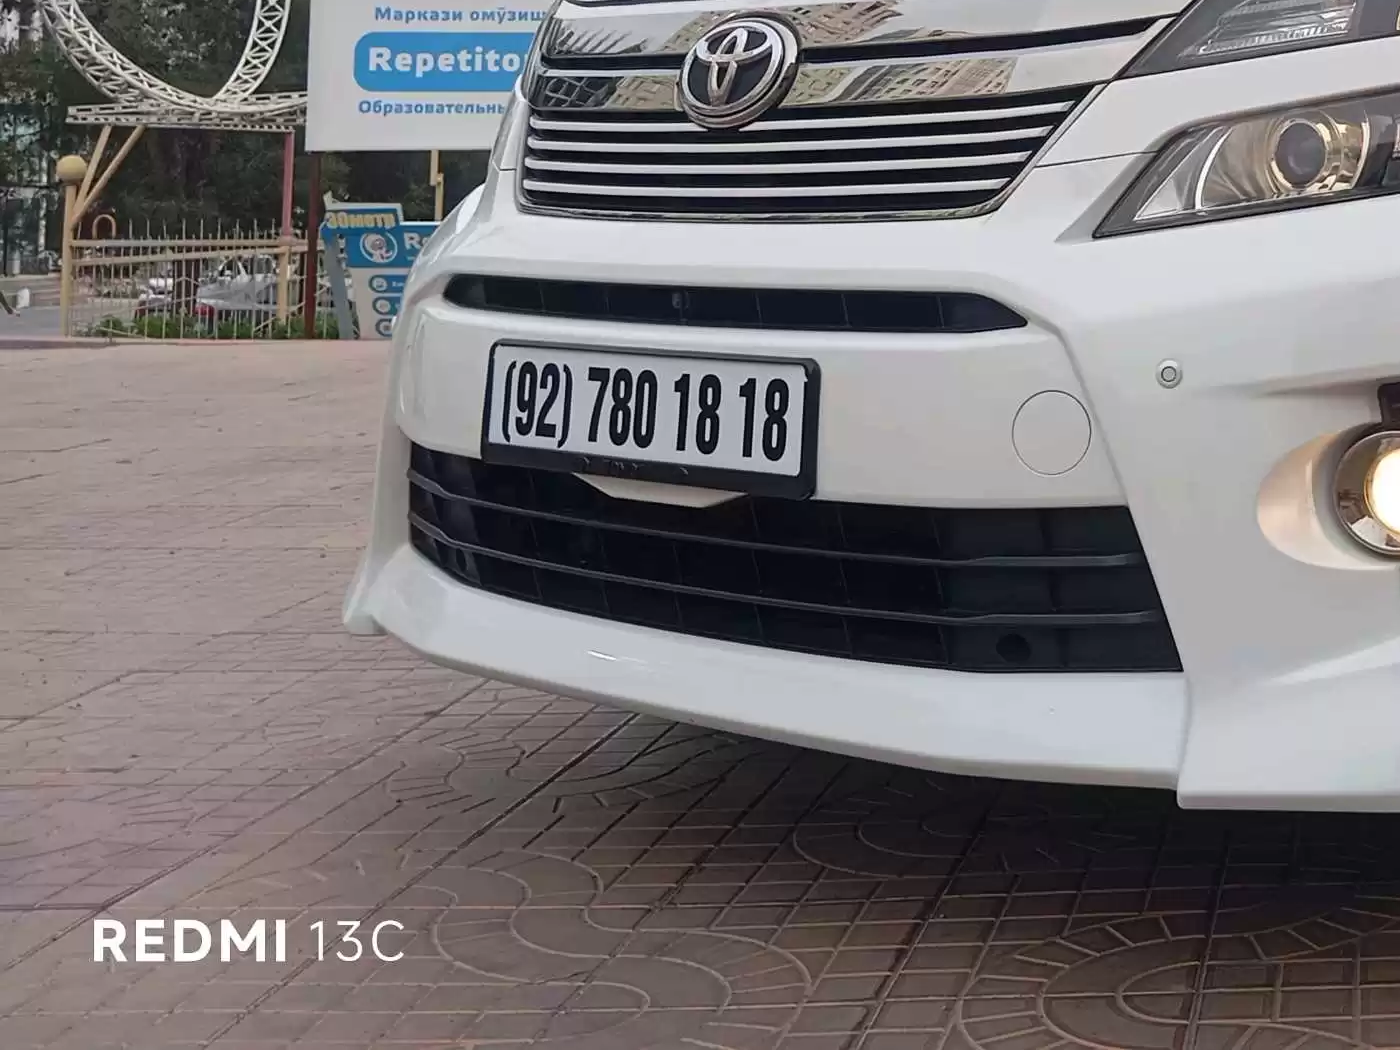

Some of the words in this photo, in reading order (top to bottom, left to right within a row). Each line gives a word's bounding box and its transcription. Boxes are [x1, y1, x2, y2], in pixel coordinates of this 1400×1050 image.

[374, 6, 463, 24] Маркази
[502, 361, 573, 448] (92)
[588, 366, 658, 449] 780
[674, 373, 722, 455] 18
[739, 378, 790, 461] 18
